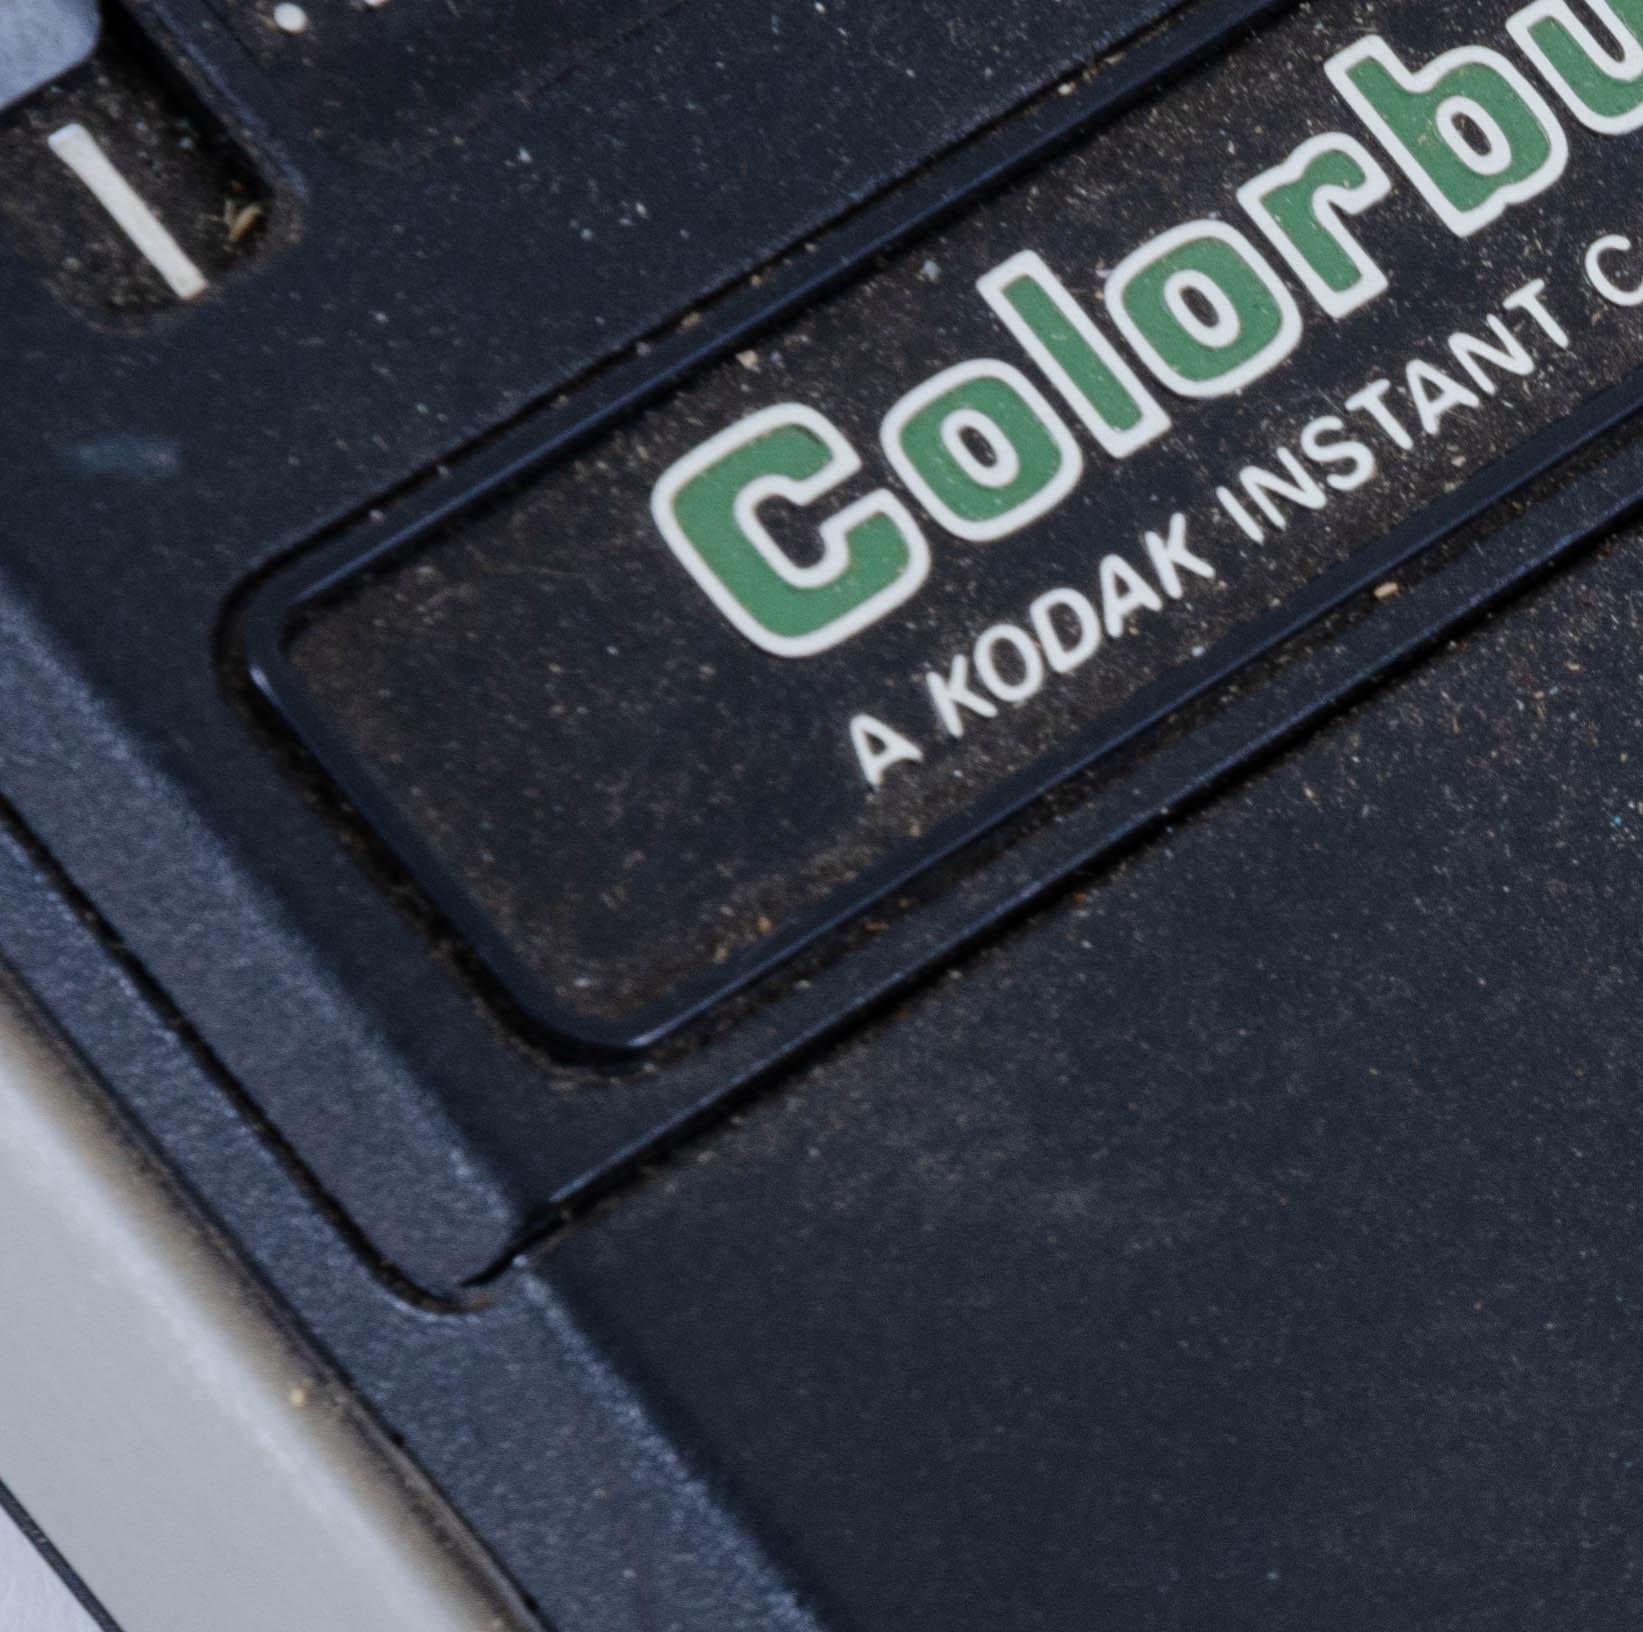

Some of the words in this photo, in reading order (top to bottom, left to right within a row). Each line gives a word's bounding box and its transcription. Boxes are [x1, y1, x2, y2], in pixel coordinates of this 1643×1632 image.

[849, 714, 924, 788] A
[925, 512, 1215, 738] KODAK
[1216, 279, 1569, 544] INSTANT
